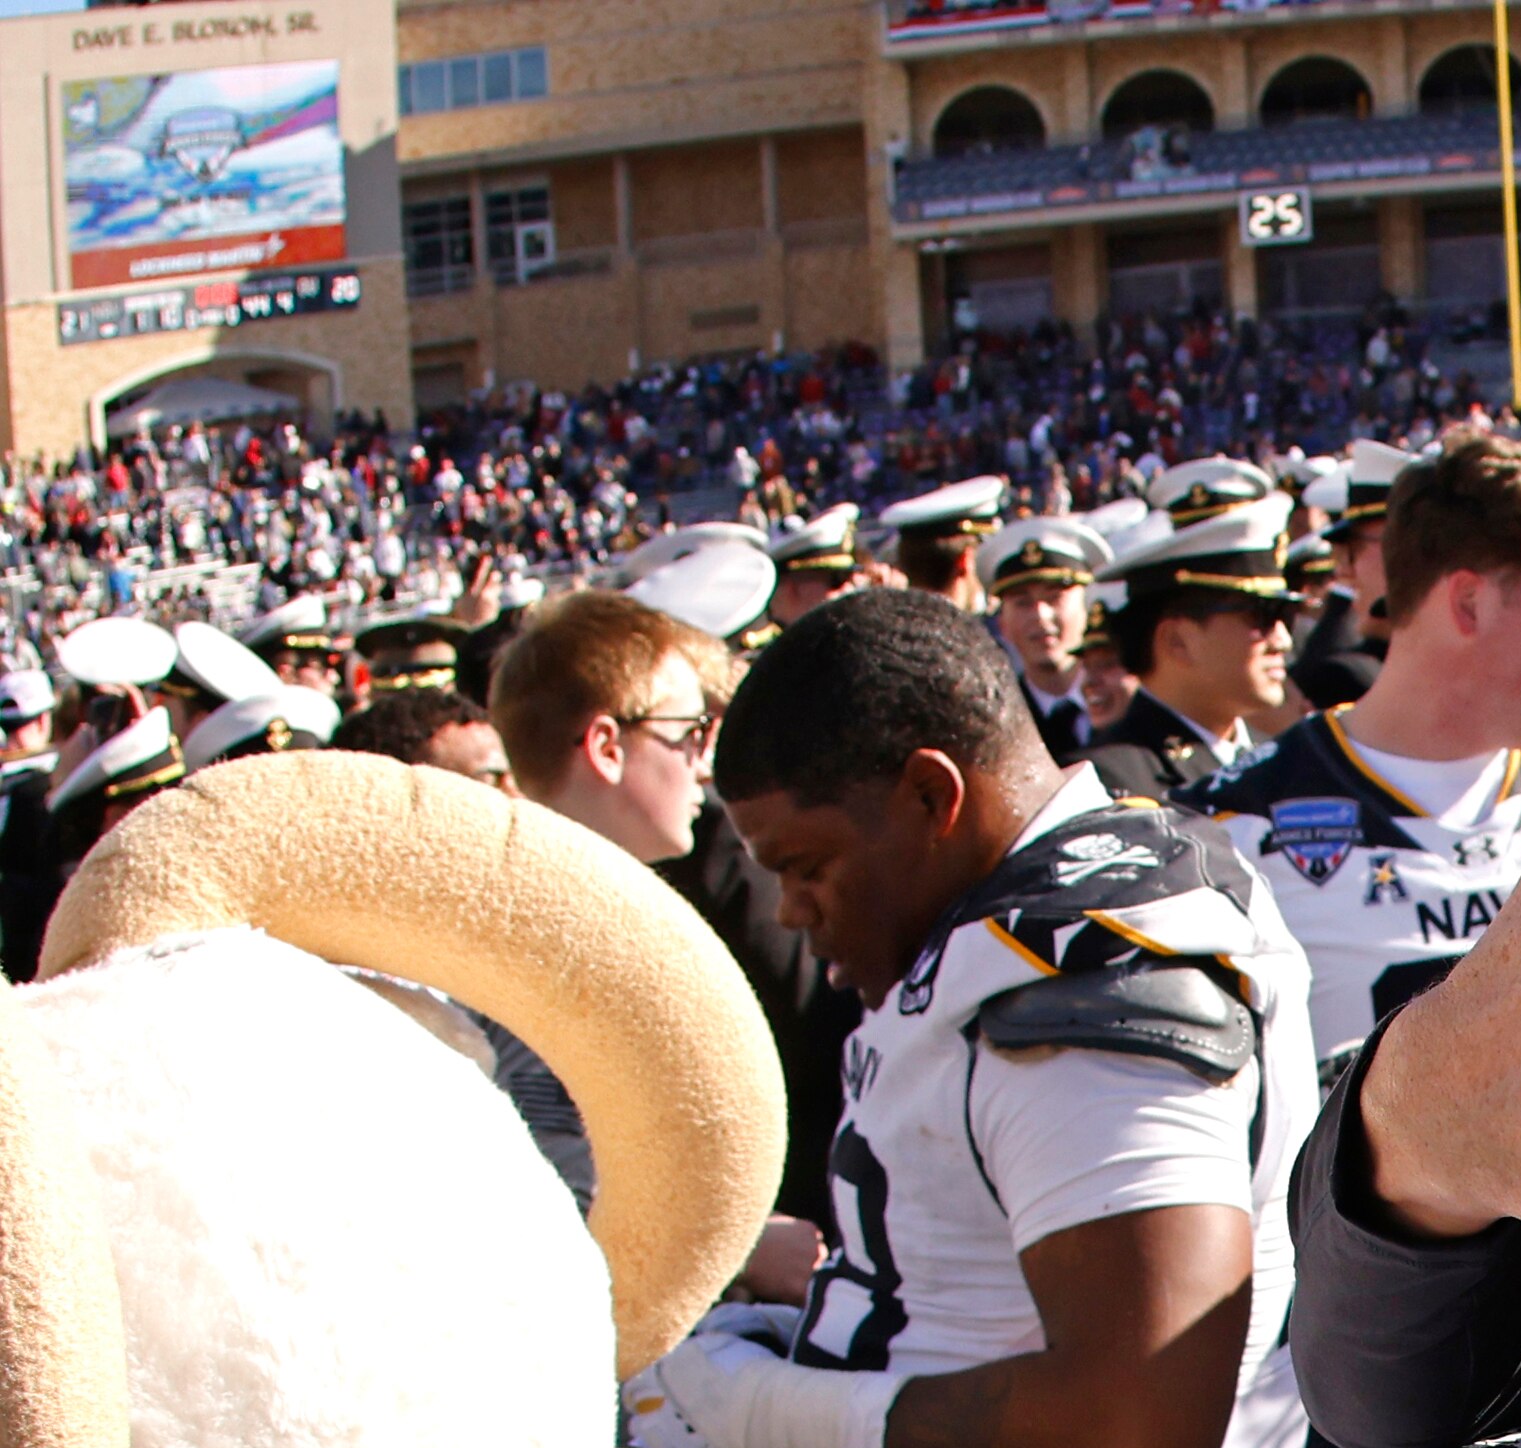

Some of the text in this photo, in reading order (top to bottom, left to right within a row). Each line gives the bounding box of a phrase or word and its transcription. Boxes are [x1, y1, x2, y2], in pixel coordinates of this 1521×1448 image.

[73, 24, 132, 49] DAVE
[1248, 194, 1304, 239] 25
[1415, 888, 1502, 944] NA
